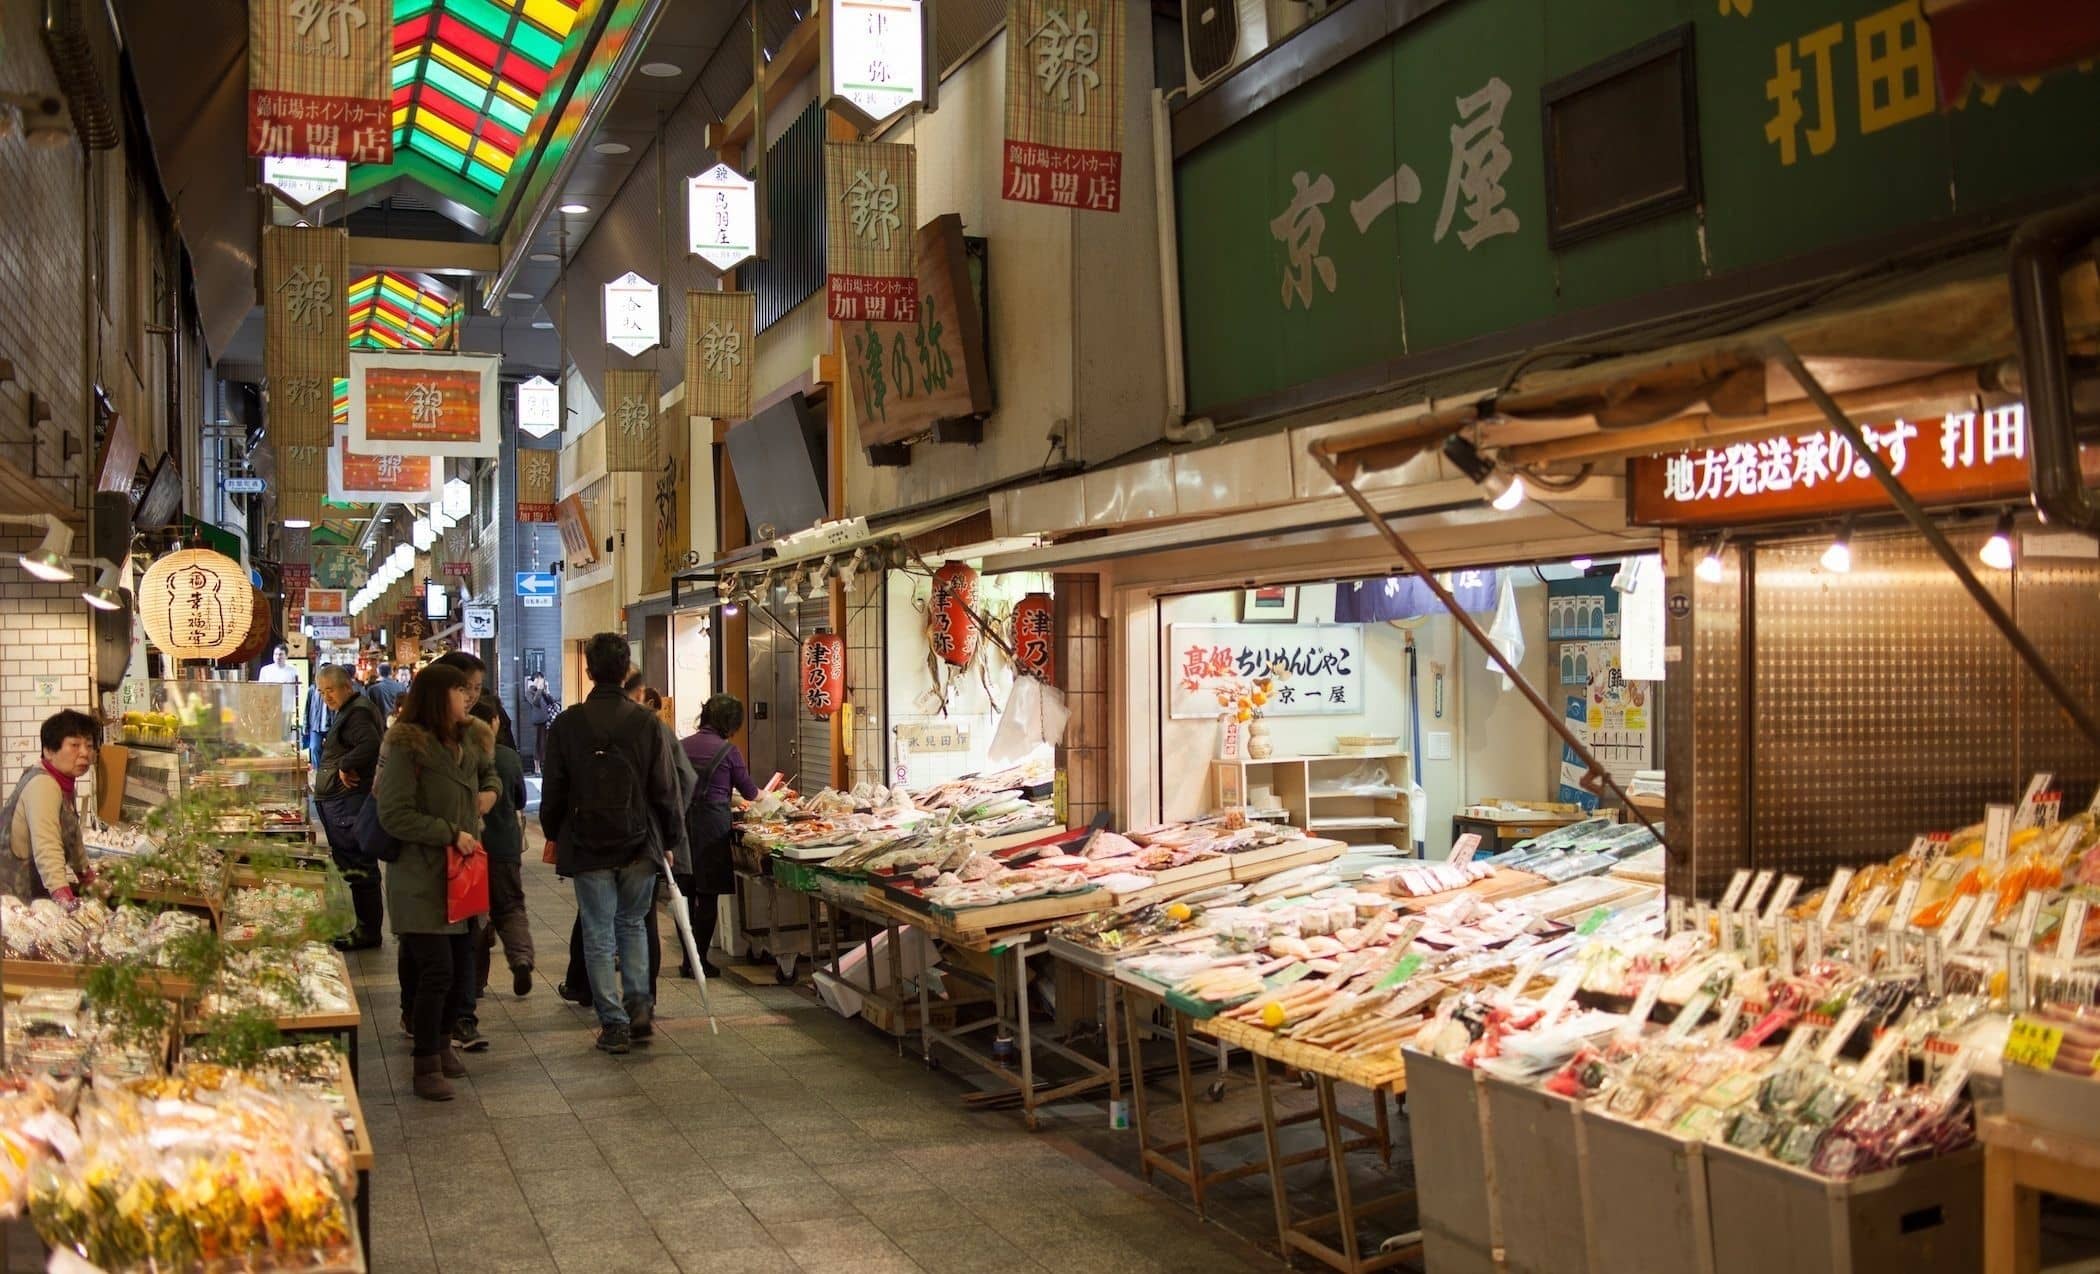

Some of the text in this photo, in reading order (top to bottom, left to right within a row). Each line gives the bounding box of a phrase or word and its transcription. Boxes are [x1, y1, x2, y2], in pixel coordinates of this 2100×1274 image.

[256, 119, 387, 163] 加盟店
[1008, 166, 1116, 209] 加盟店
[1270, 77, 1520, 311] 京一屋
[832, 293, 915, 321] 加盟店
[1940, 402, 2025, 469] 打田
[1022, 609, 1051, 680] 津乃
[804, 641, 832, 708] 津乃弥
[1278, 685, 1347, 704] 京一屋
